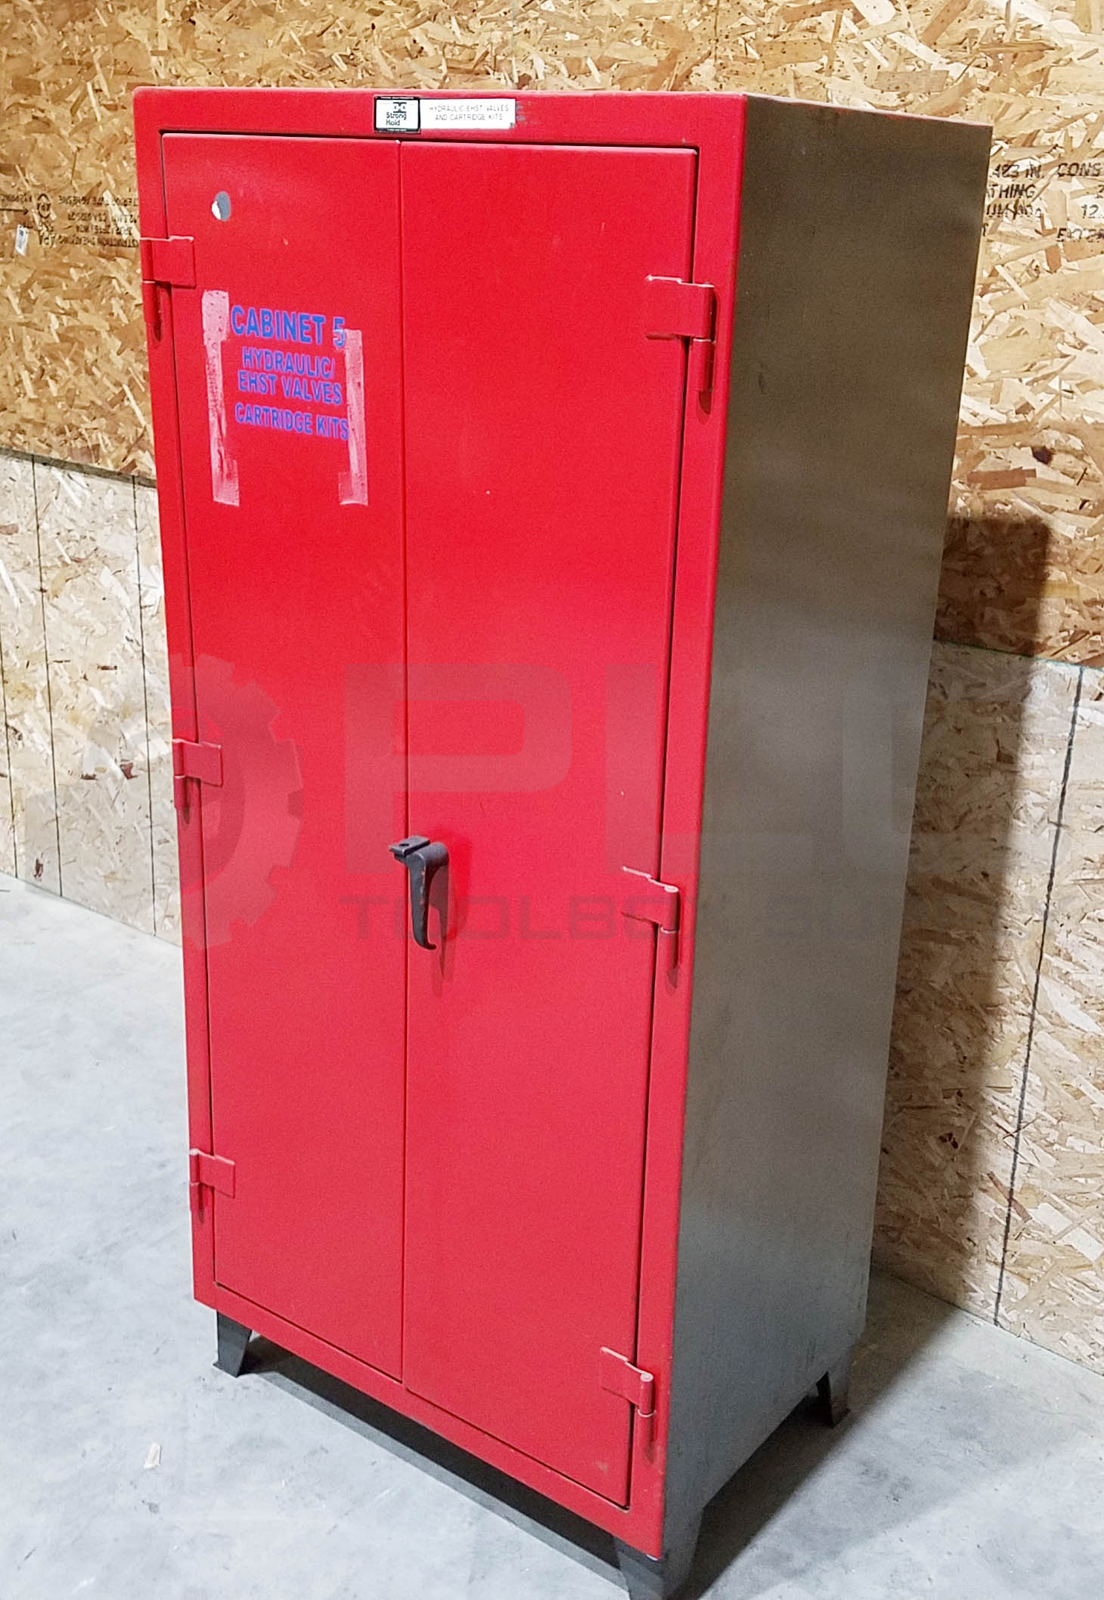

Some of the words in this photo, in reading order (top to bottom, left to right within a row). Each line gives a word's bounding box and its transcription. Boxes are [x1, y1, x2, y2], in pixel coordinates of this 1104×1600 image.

[385, 111, 407, 121] Strong
[435, 113, 448, 121] AND
[450, 113, 485, 121] CARTRIDGE
[488, 113, 503, 121] KITS
[231, 305, 326, 346] CABINET
[332, 317, 346, 348] 5
[237, 371, 277, 396] EHST
[281, 377, 343, 405] VALVES
[234, 403, 313, 435] CARTRIDGE
[315, 415, 349, 441] KITS
